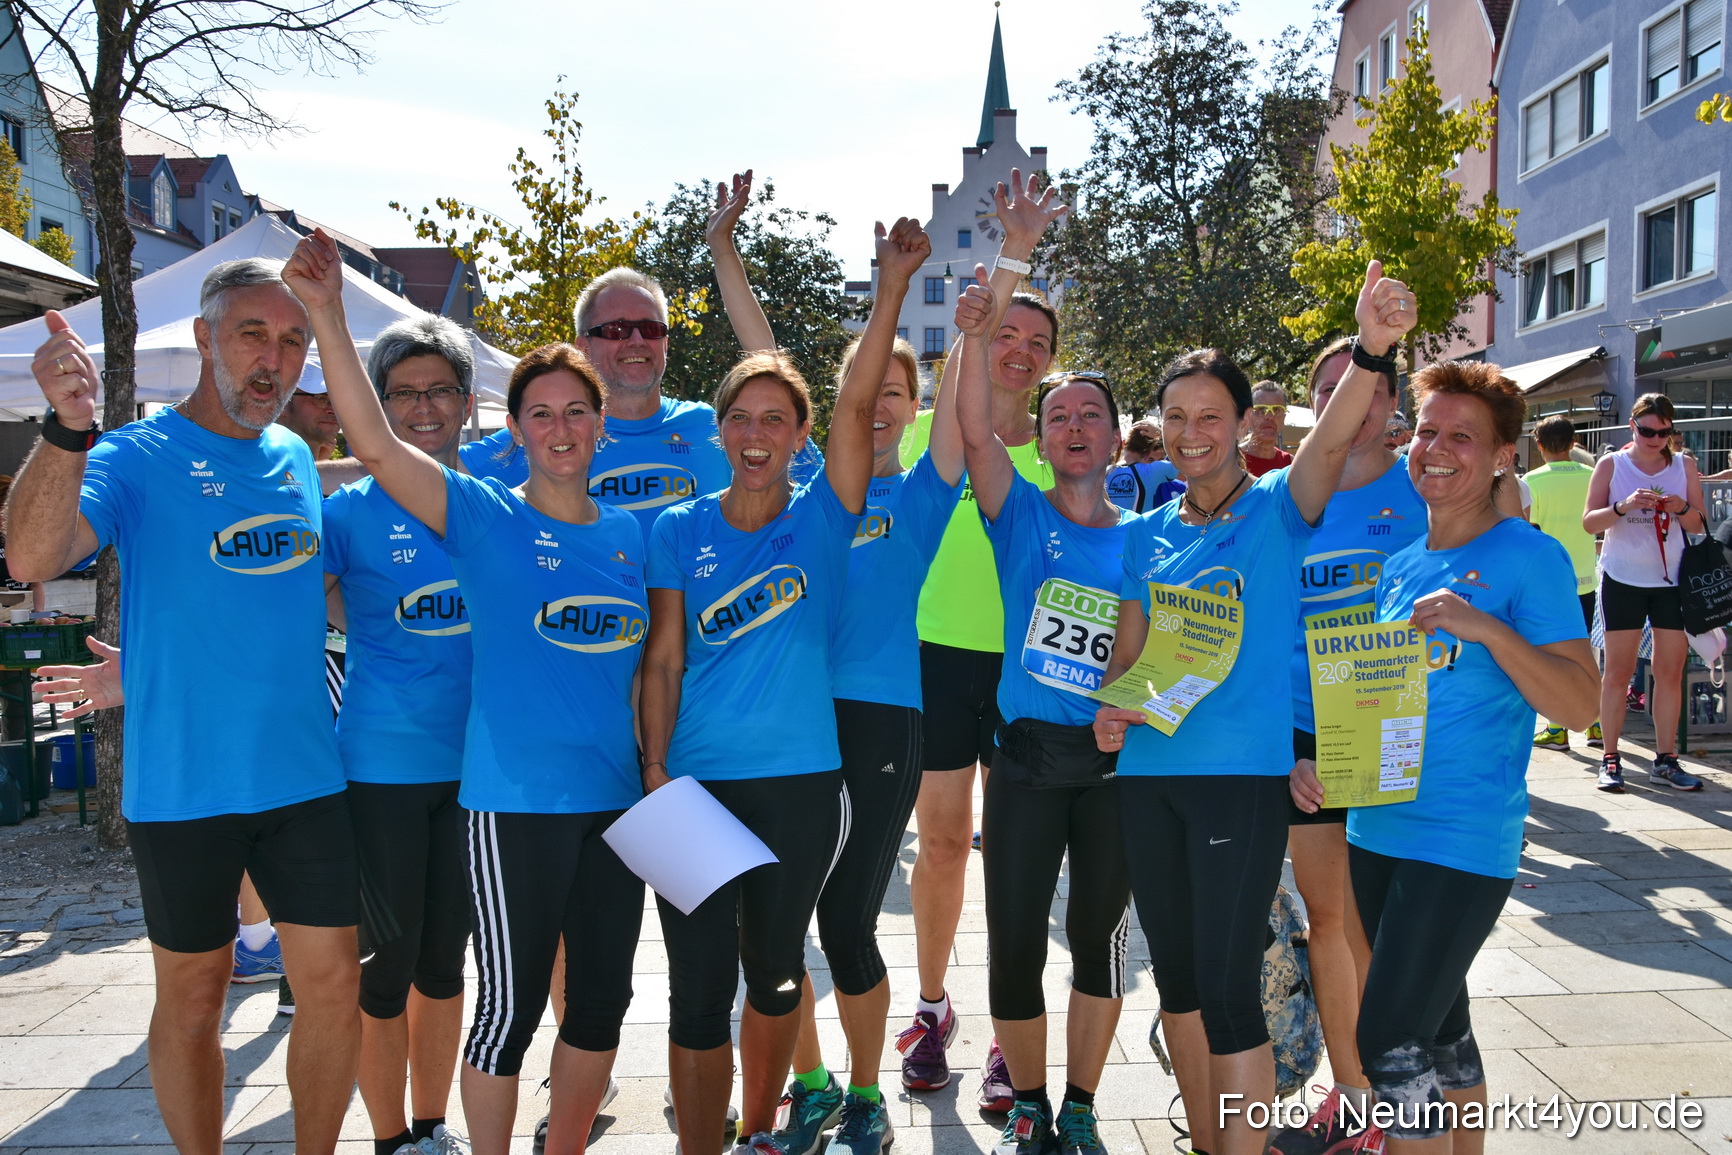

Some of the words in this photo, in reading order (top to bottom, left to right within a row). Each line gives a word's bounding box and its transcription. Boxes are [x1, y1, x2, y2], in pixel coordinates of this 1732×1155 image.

[586, 476, 697, 498] LAUF10!
[213, 531, 320, 557] LAUF10!
[535, 539, 559, 548] erima
[696, 552, 717, 561] erima
[1155, 589, 1238, 623] URKUNDE
[541, 601, 648, 645] LAUF10!
[1154, 610, 1183, 633] 20
[1183, 617, 1237, 639] Neumarkter
[1041, 616, 1115, 663] 236
[1182, 628, 1225, 649] Stadtlauf
[1185, 644, 1208, 655] September
[1314, 627, 1419, 655] URKUNDE
[1317, 660, 1354, 685] 20
[1354, 654, 1419, 669] Neumarkter
[1355, 666, 1407, 682] Stadtlauf
[1363, 686, 1392, 694] September
